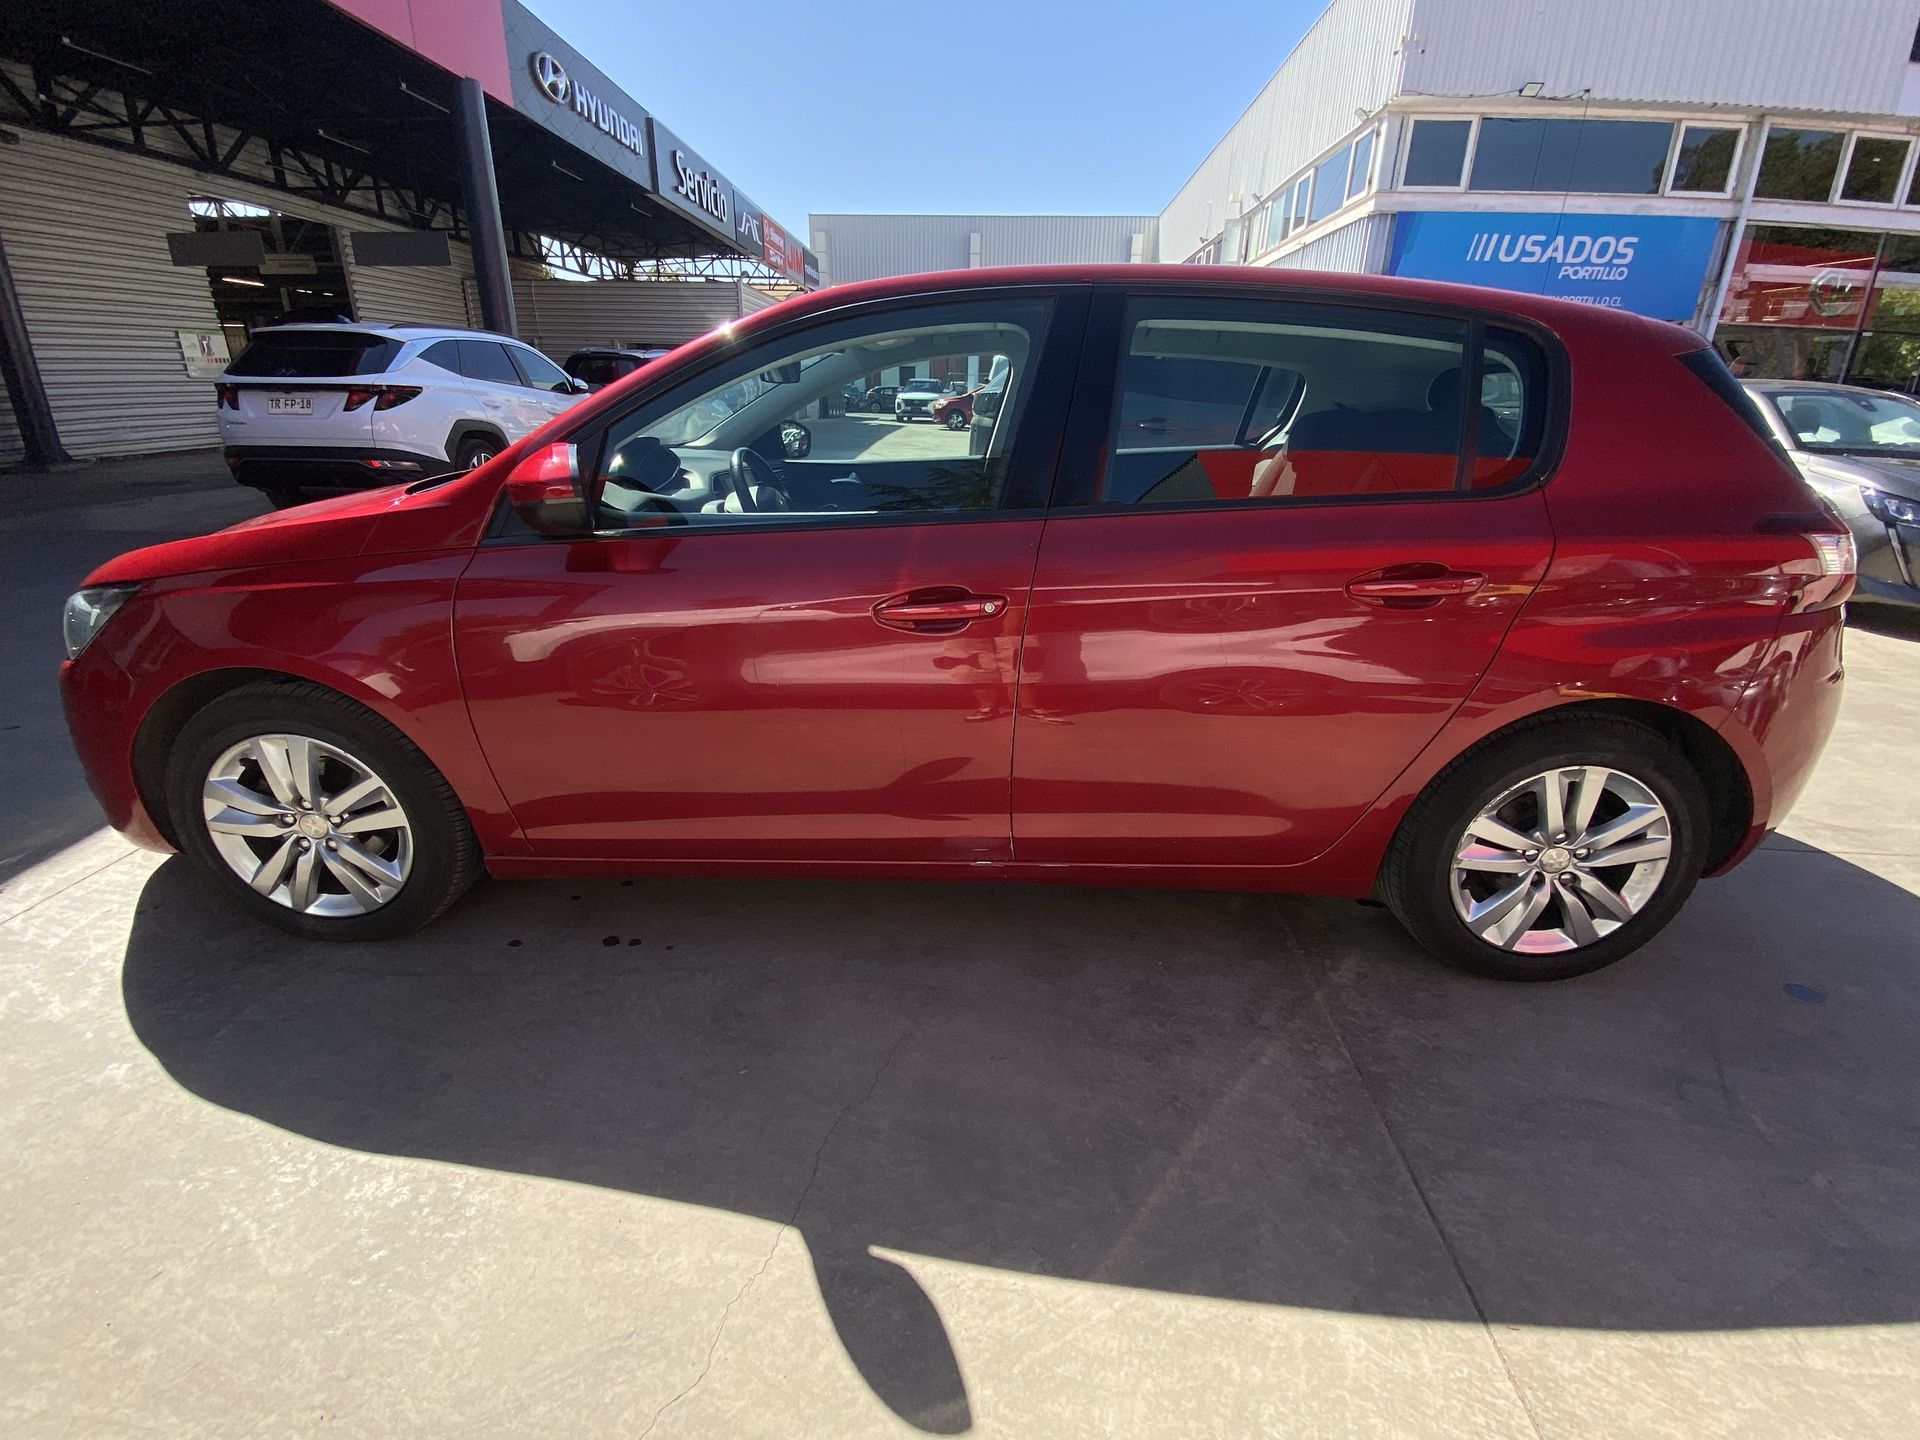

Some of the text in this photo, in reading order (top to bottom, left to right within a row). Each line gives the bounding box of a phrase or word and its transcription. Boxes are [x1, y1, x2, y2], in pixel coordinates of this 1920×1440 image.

[573, 80, 643, 156] HYUNDAI
[674, 149, 728, 223] Servicio
[737, 211, 762, 246] JAC
[1498, 234, 1639, 265] USADOS
[1558, 265, 1629, 281] PORTILLO
